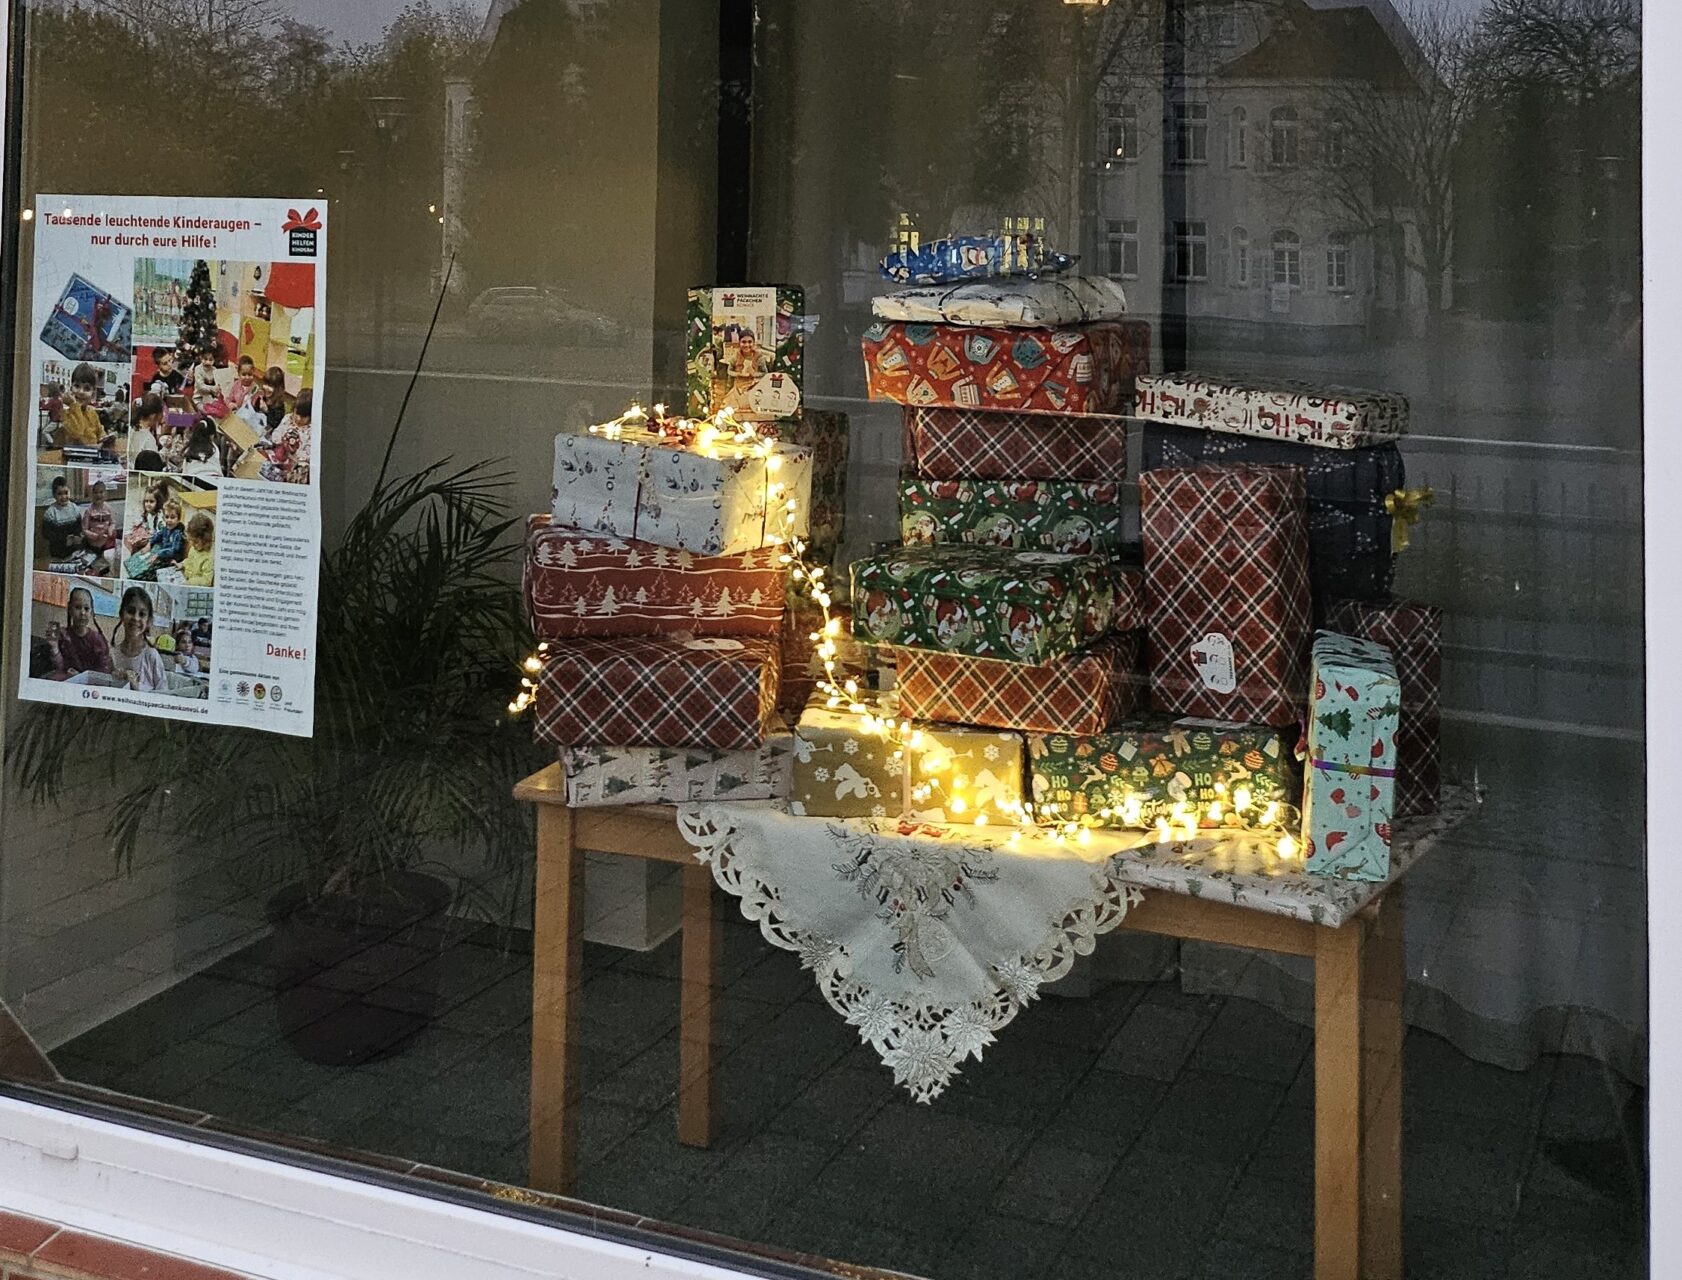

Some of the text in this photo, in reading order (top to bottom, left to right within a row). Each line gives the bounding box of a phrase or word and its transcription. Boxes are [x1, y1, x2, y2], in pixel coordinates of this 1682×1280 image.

[44, 213, 101, 227] Tausende
[105, 213, 171, 228] leuchtende
[173, 216, 250, 232] Kinderaugen
[91, 234, 111, 245] nur
[114, 233, 149, 247] durch
[152, 236, 177, 248] eure
[1052, 775, 1069, 788] HO
[1195, 773, 1212, 786] HO
[1056, 789, 1072, 801] HO
[1200, 788, 1215, 800] HO
